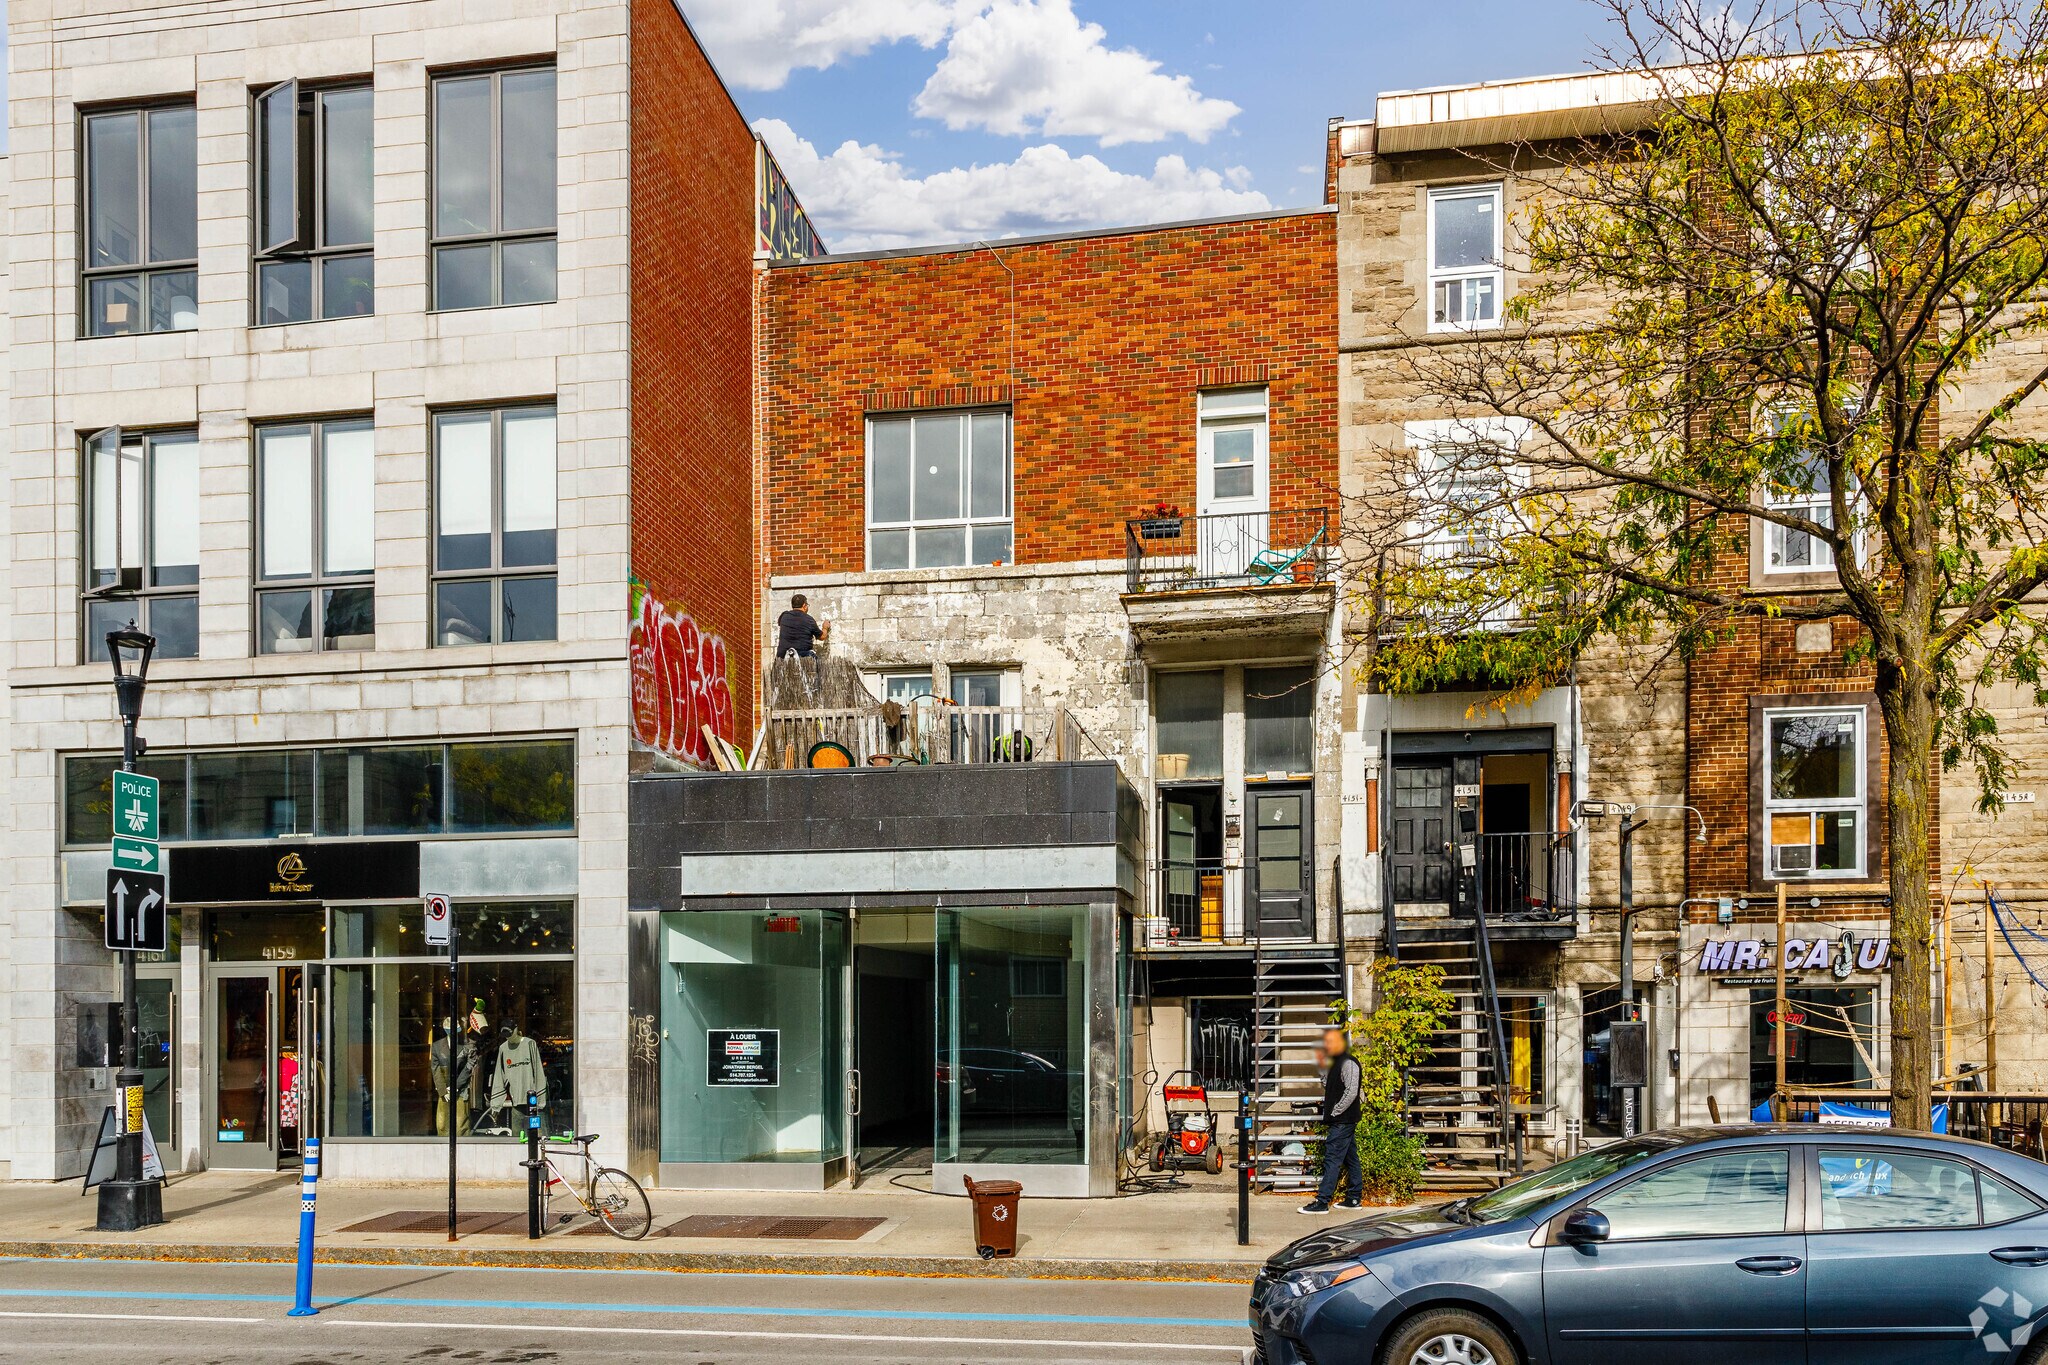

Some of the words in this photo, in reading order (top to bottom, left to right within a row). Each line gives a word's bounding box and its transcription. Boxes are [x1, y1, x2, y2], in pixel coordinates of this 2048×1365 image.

[121, 782, 152, 798] POLICE
[1456, 786, 1477, 794] 4151
[262, 945, 297, 960] 4159
[1699, 939, 1769, 971] MR.
[1785, 931, 1891, 978] CAJU
